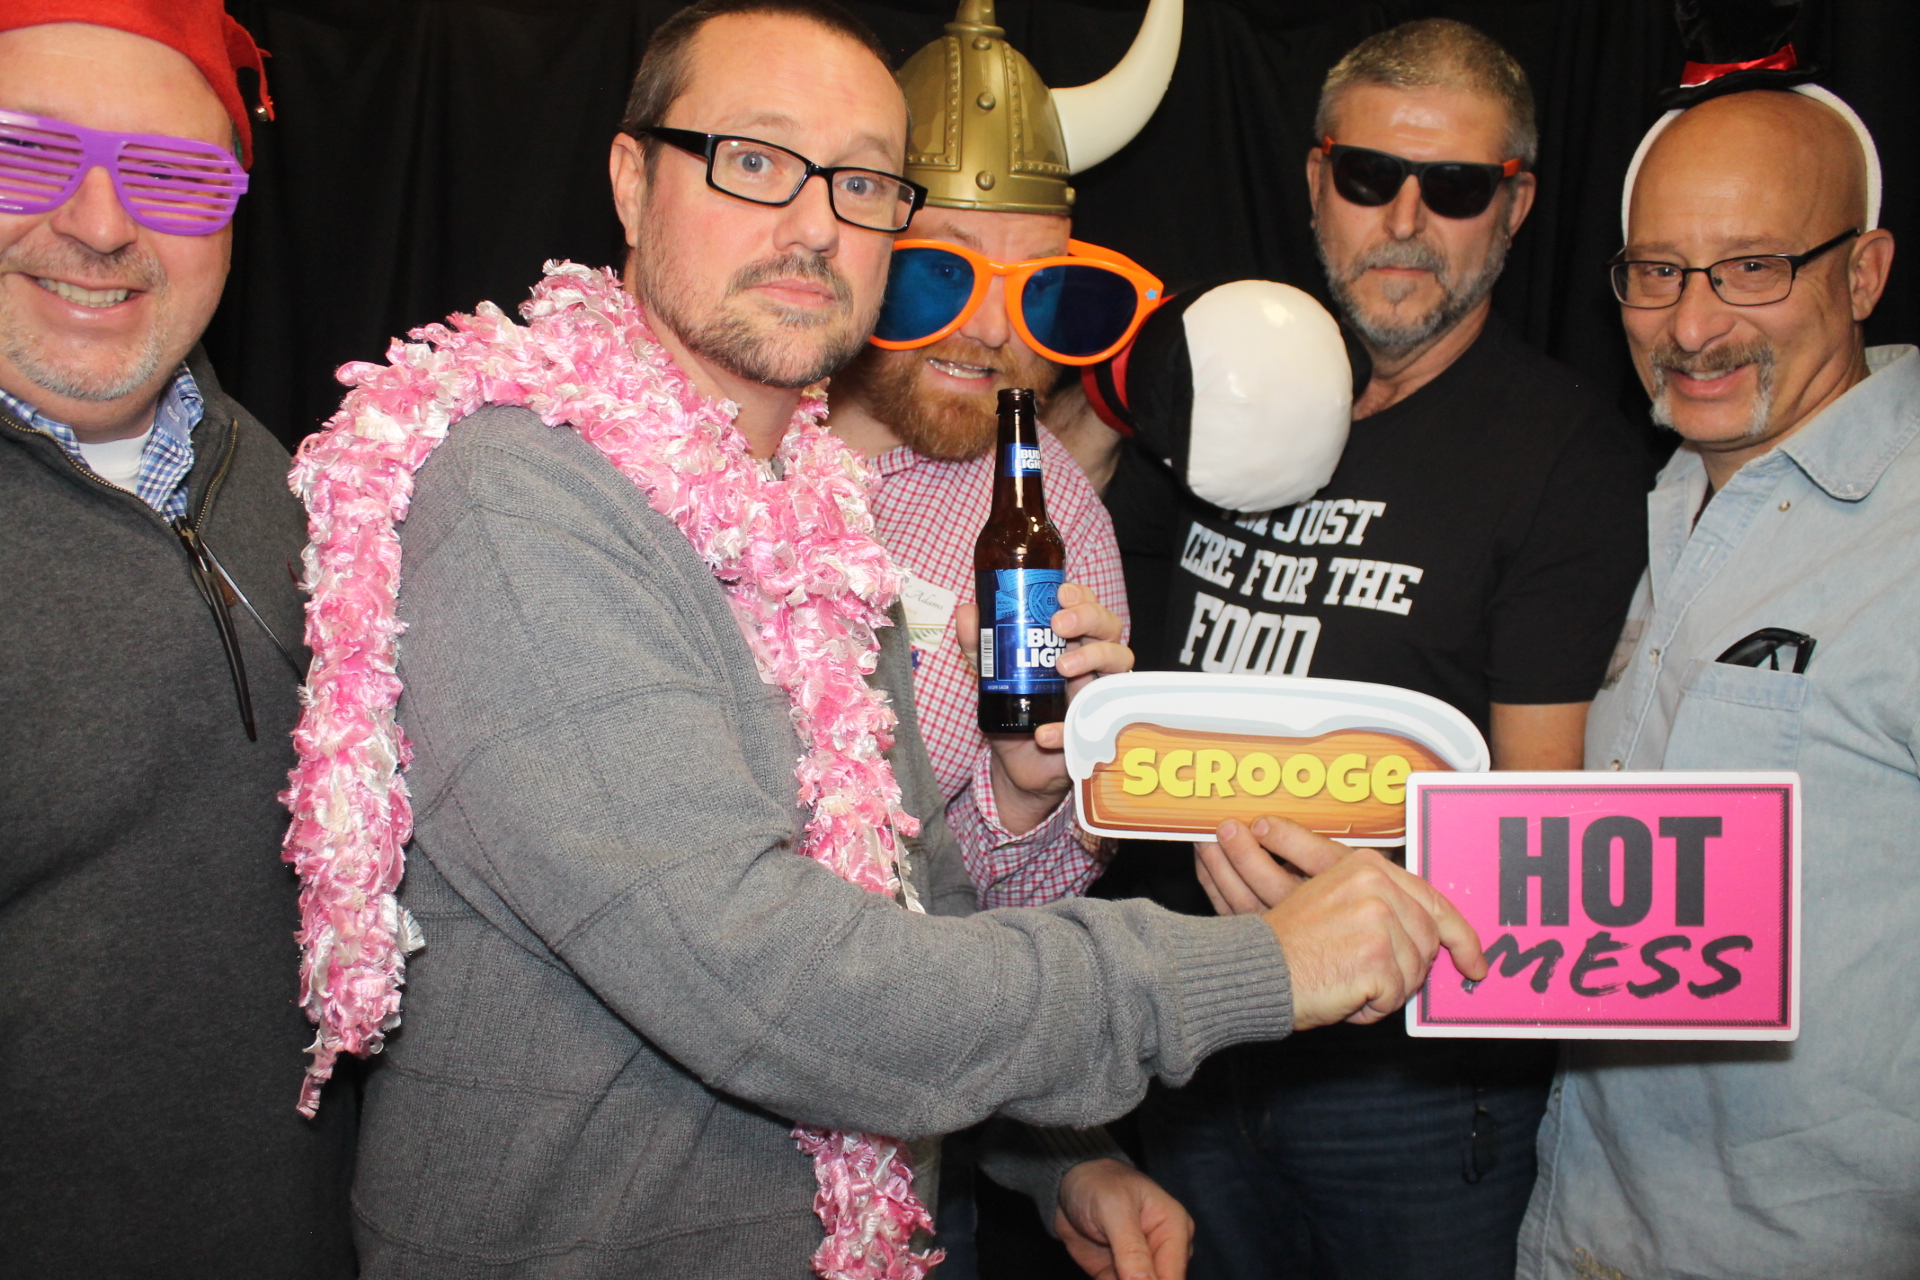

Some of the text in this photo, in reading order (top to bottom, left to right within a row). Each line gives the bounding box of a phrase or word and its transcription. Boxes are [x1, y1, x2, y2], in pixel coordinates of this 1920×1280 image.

[1272, 499, 1386, 546] JUST
[1239, 549, 1318, 605] FOR
[1323, 556, 1424, 616] THE
[1179, 591, 1322, 678] FOOD
[1498, 815, 1723, 928] HOT
[1461, 931, 1754, 999] MESS
